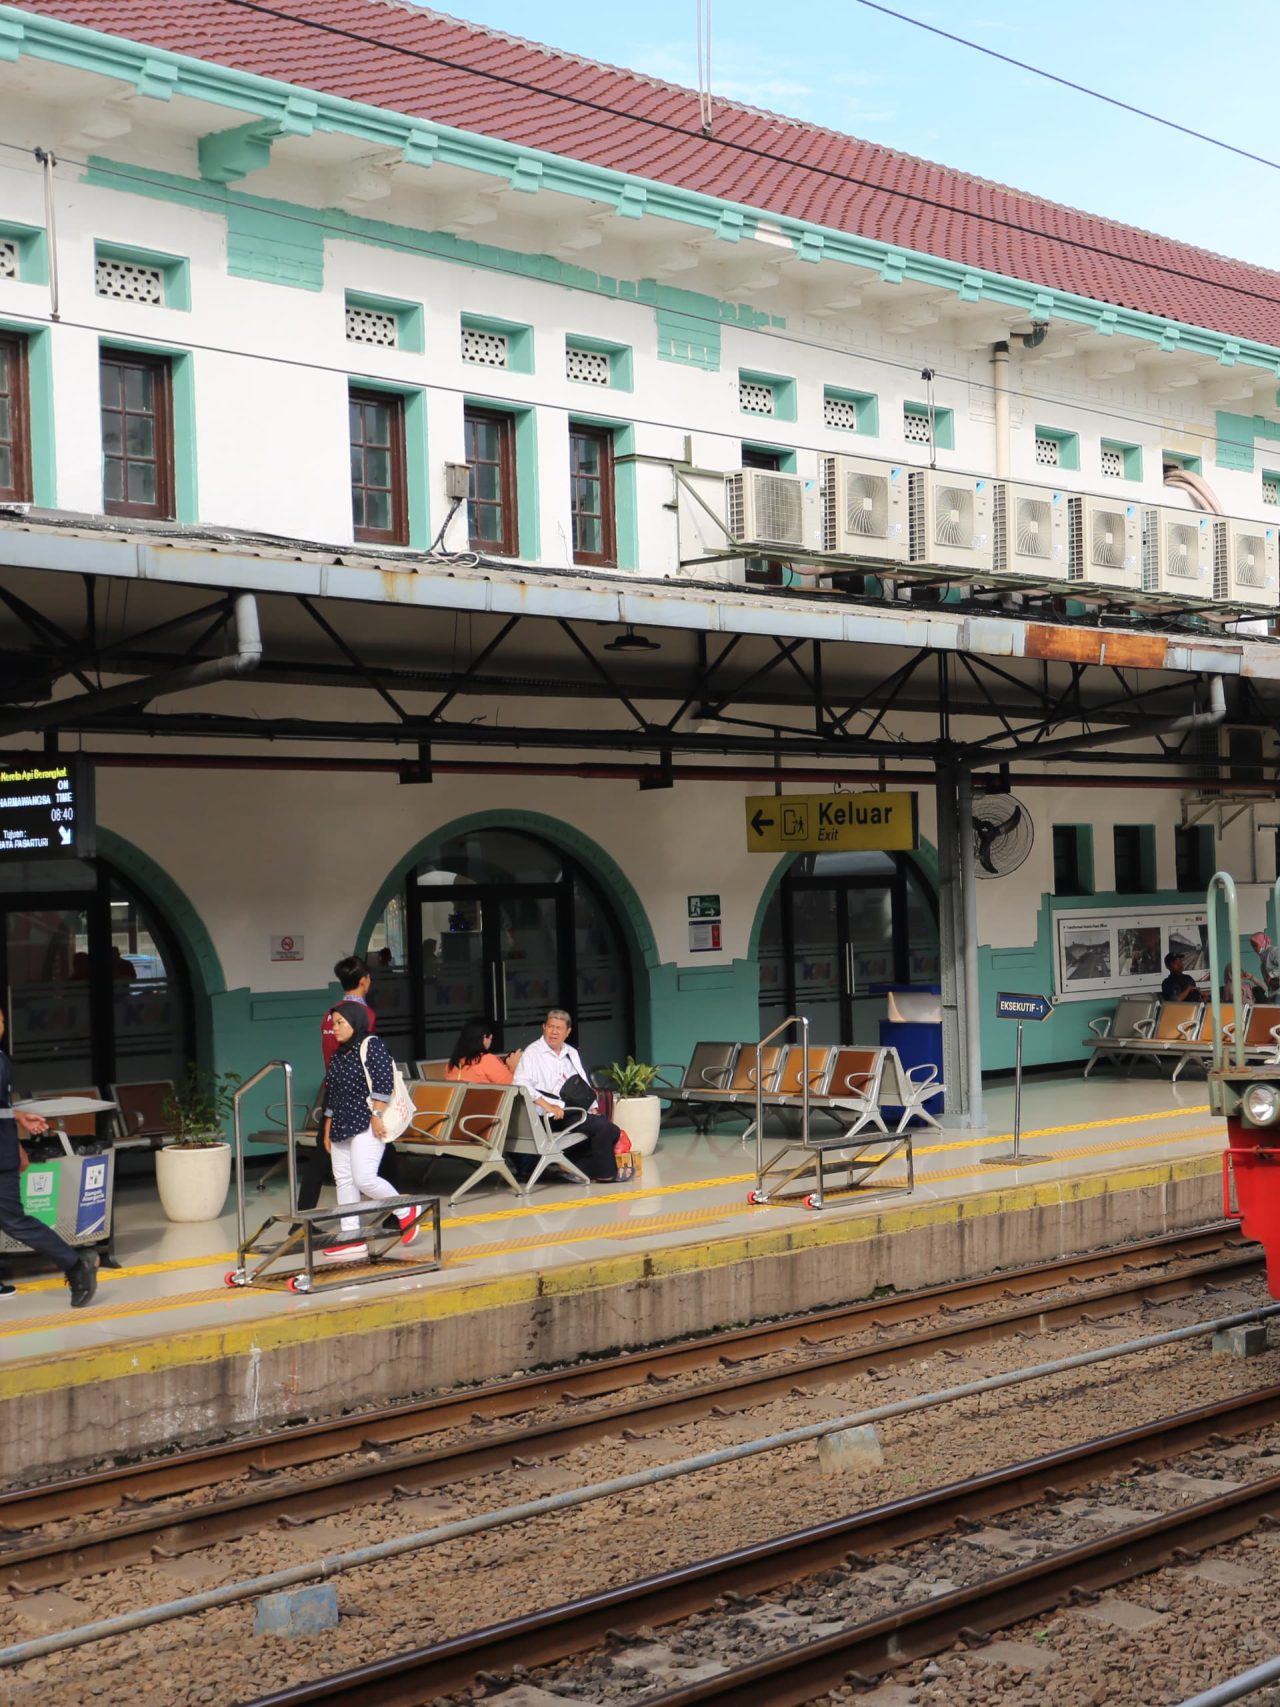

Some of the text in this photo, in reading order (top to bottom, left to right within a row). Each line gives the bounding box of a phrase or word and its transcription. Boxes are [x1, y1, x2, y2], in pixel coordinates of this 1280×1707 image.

[22, 769, 33, 781] Api
[34, 766, 67, 779] Berangkat
[57, 780, 69, 790] ON
[55, 792, 73, 803] TIME
[50, 807, 74, 822] 08:40
[819, 801, 893, 826] Keluar
[817, 828, 839, 841] Exit
